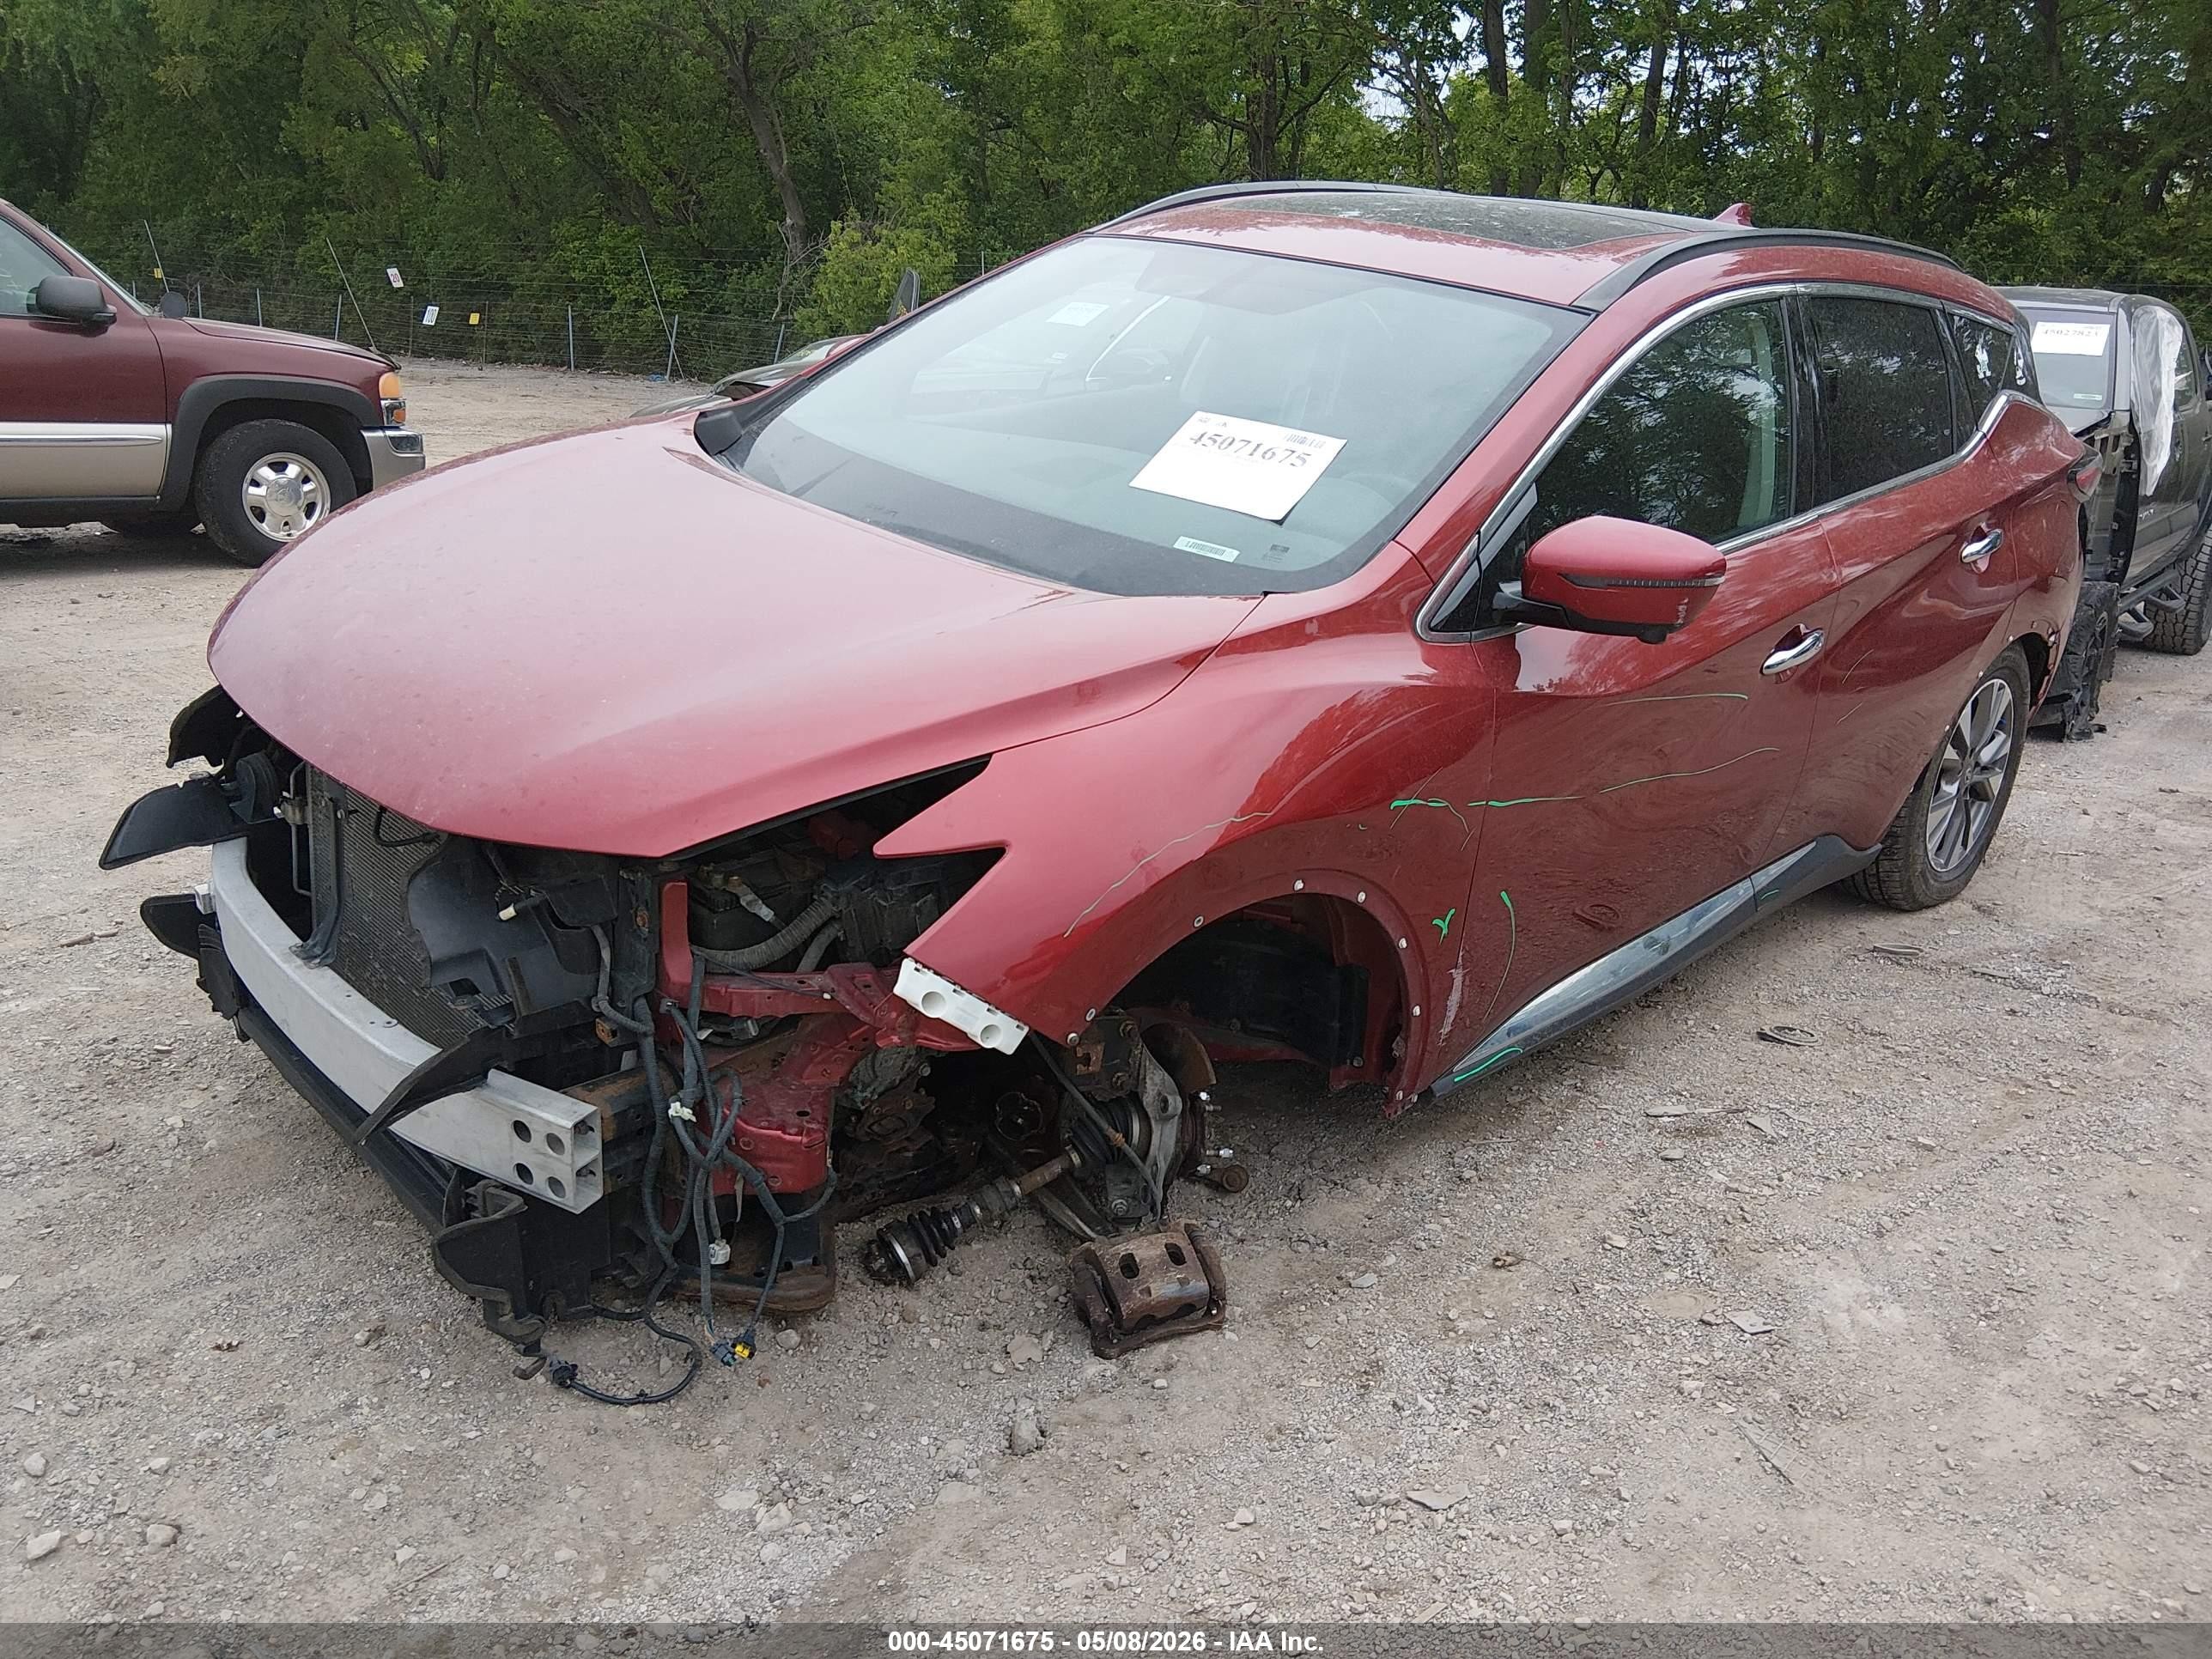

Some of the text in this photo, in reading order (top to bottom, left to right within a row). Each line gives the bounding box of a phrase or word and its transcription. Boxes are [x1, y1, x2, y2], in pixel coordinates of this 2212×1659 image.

[390, 273, 400, 283] 20
[425, 308, 436, 324] 100
[1189, 431, 1312, 467] 45071675
